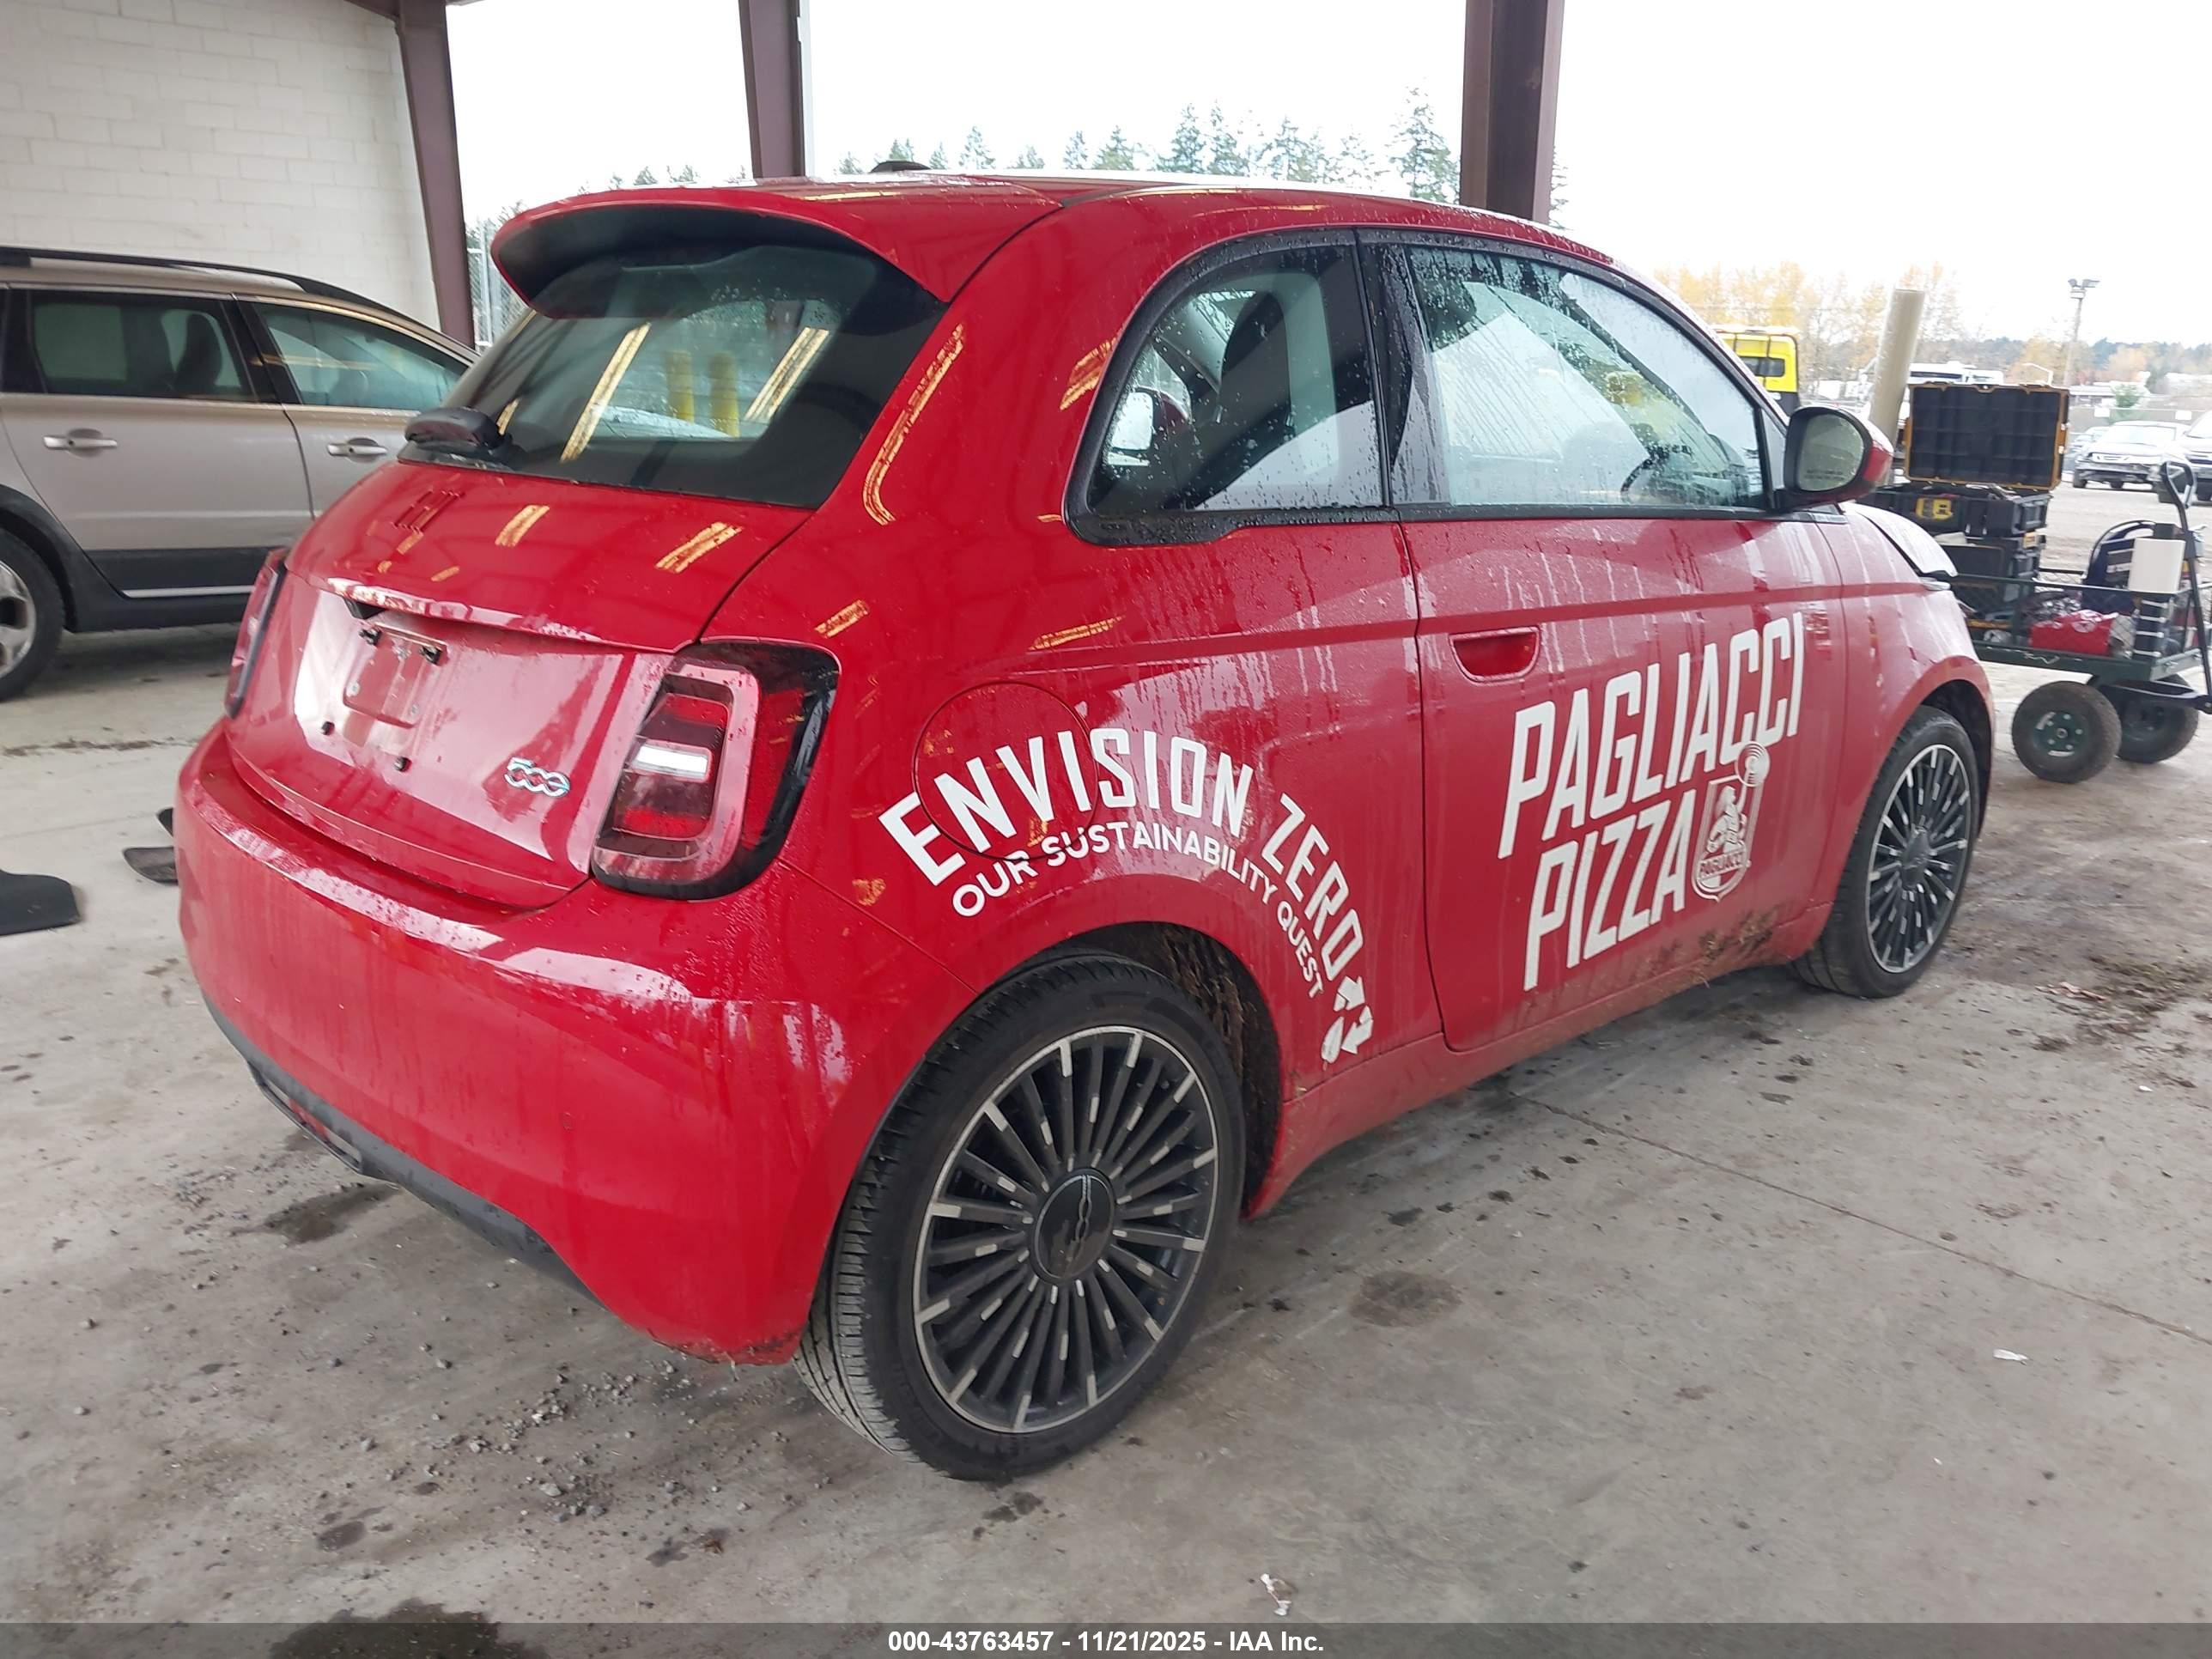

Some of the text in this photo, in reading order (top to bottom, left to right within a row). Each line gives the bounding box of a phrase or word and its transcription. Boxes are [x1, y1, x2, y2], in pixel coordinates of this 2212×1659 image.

[1498, 612, 1802, 859] PAGLIACCI
[878, 728, 1364, 981] ENVISION ZERO
[952, 822, 1323, 998] OUR SUSTAINABILITY QUEST
[1523, 789, 1696, 991] PIZZA
